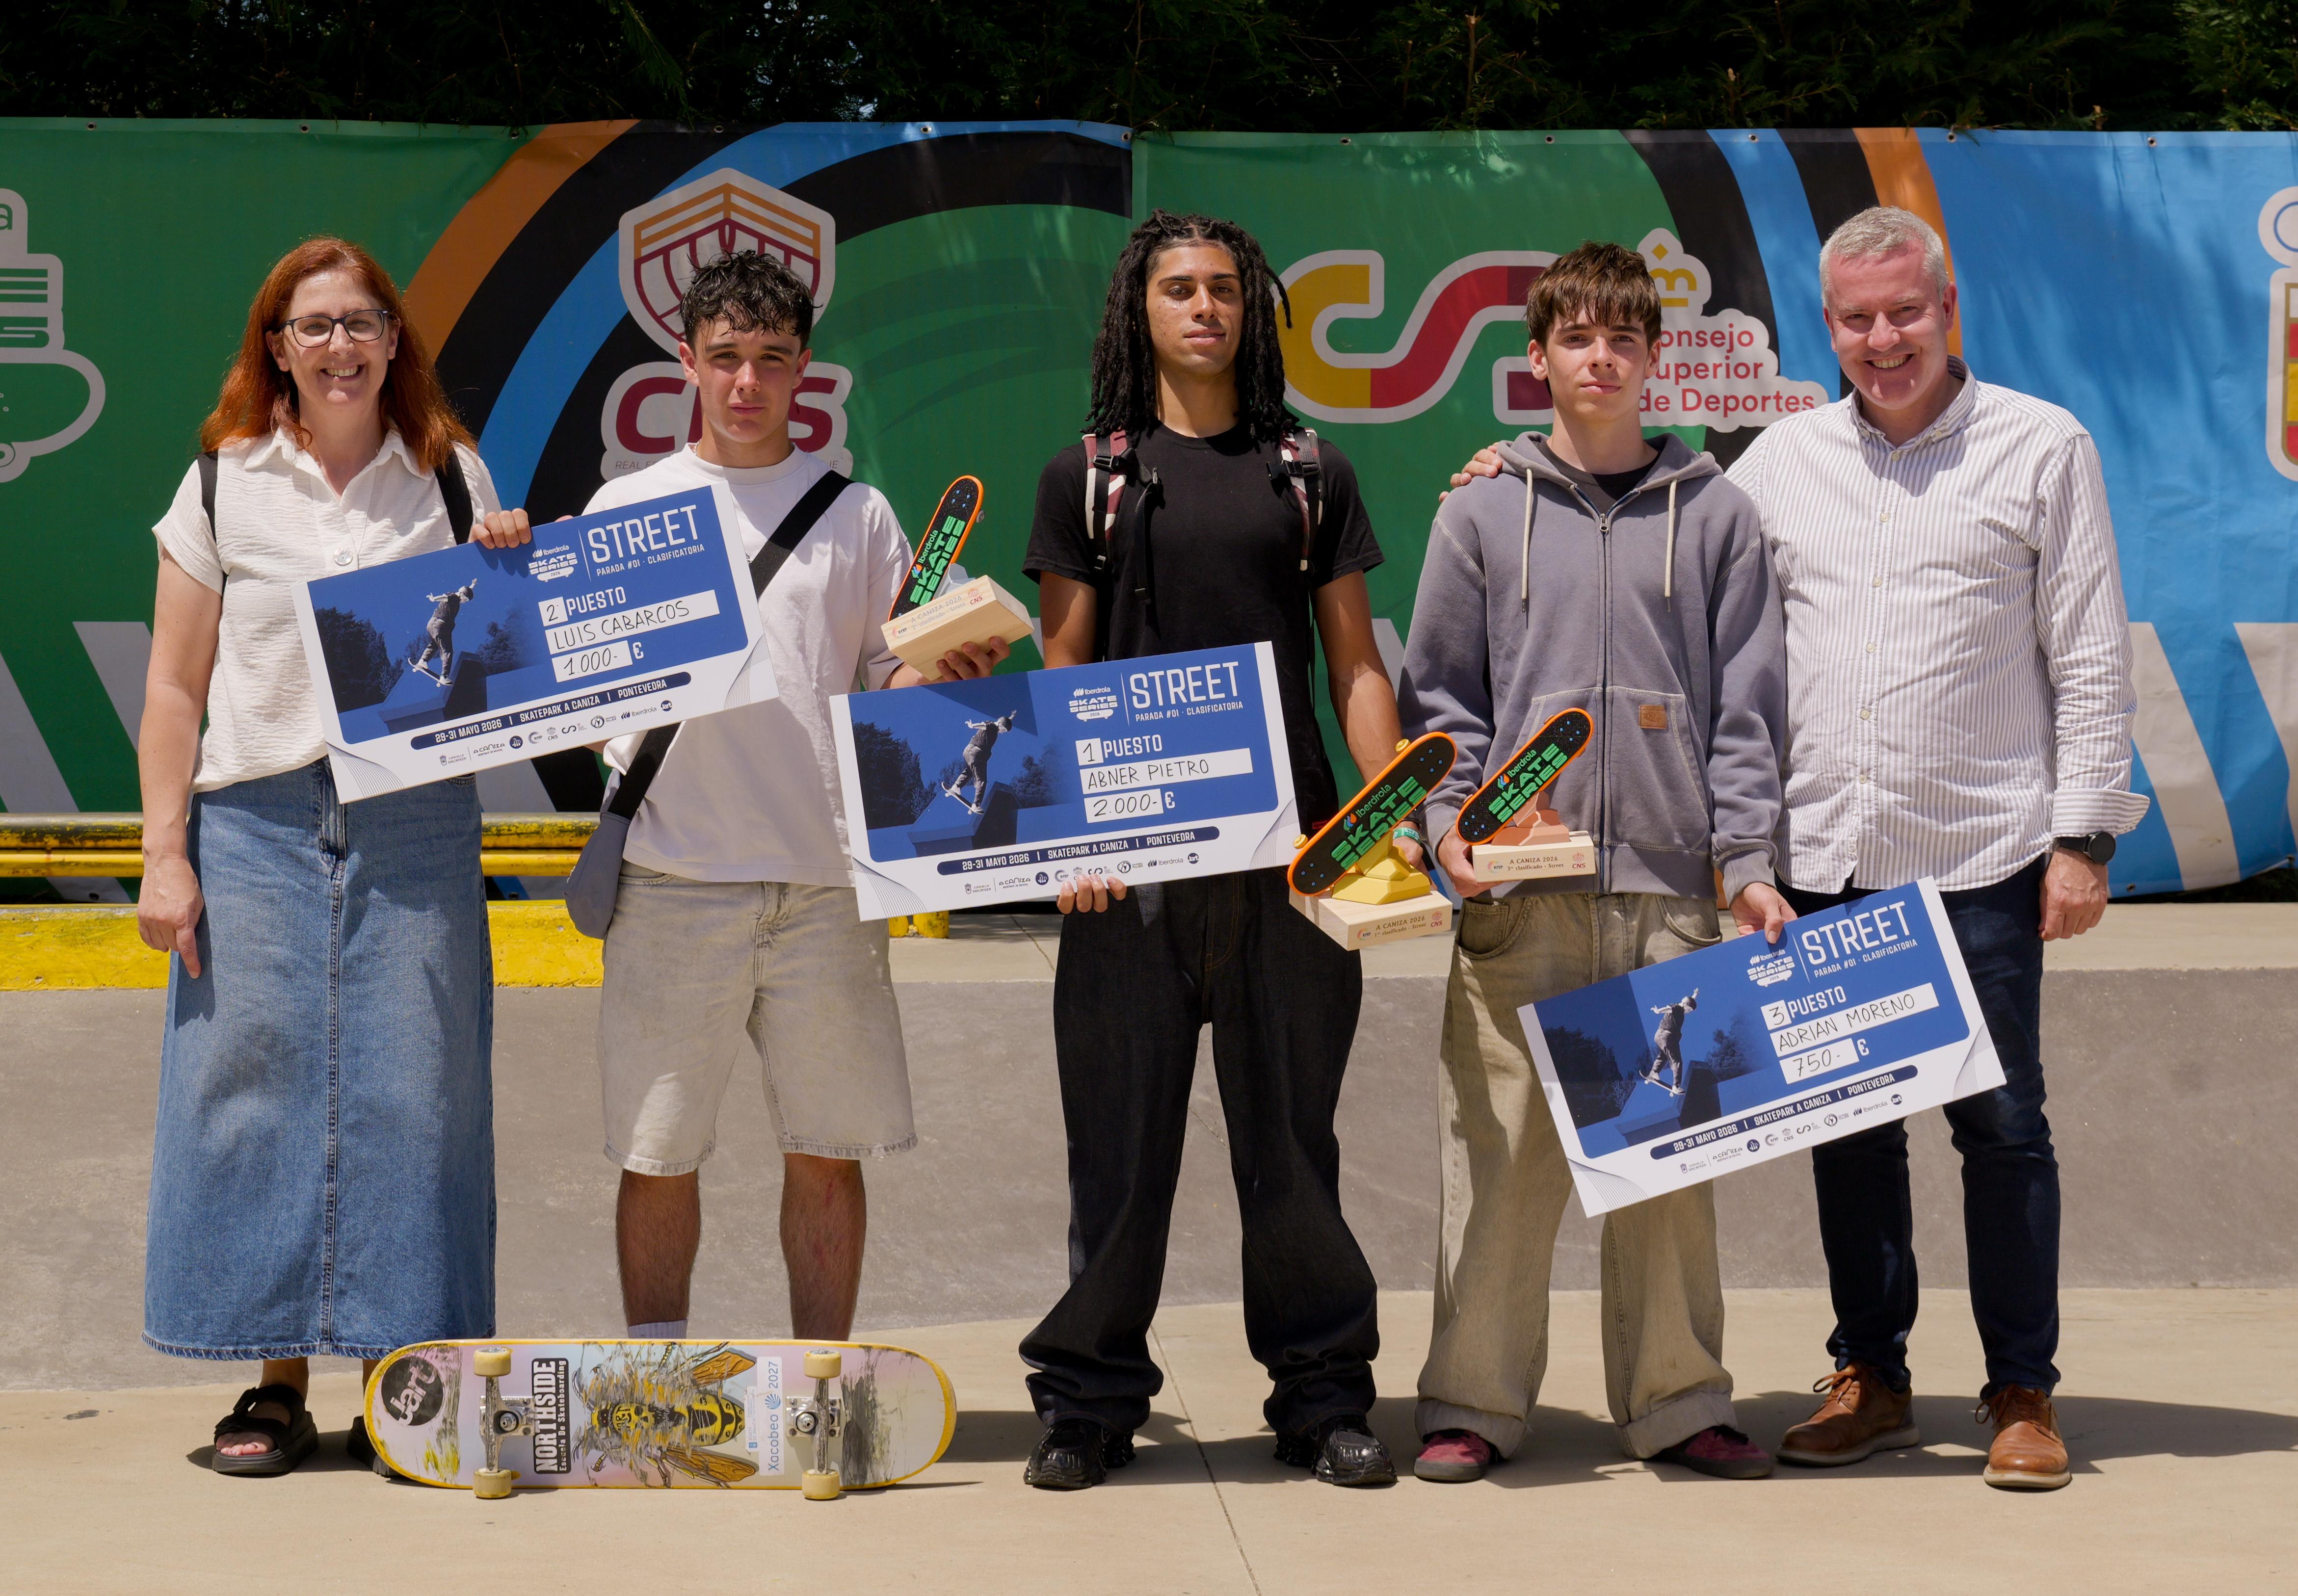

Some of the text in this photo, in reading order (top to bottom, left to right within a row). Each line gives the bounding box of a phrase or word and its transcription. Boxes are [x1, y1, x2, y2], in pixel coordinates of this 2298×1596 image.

[1660, 323, 1754, 354] onsejo
[1655, 355, 1764, 385] uperior
[615, 376, 838, 454] CS
[1639, 388, 1815, 418] de Deportes
[615, 461, 641, 470] REAL
[587, 505, 698, 564] STREET
[918, 530, 938, 564] Iberdrola
[528, 552, 577, 569] SKATE
[543, 545, 570, 556] Iberdrola
[596, 563, 625, 576] PARADA
[648, 544, 705, 565] CLASIFICATORIA
[910, 515, 956, 603] SKATE
[919, 520, 966, 606] SERIES
[530, 558, 578, 575] SERIES
[566, 586, 627, 616] PUESTO
[918, 604, 944, 620] CANIZA
[945, 595, 962, 607] 2026
[920, 612, 945, 627] clasificado
[950, 602, 966, 612] Street
[970, 595, 982, 605] CNS
[555, 601, 689, 650] LUIS CABARCOS
[633, 642, 644, 659] €
[1084, 686, 1110, 695] Iberdrola
[1130, 661, 1239, 709] STREET
[458, 724, 480, 737] MAYO
[482, 719, 502, 732] 2026
[520, 704, 562, 723] SKATEPARK
[564, 703, 570, 711] A
[571, 695, 601, 710] CANIZA
[618, 679, 667, 699] PONTEVEDRA
[632, 706, 657, 717] Iberdrola
[1069, 695, 1117, 707] SKATE
[1070, 702, 1118, 712] SERIES
[1135, 711, 1163, 722] PARADA
[1187, 701, 1243, 716] CLASIFICATORIA
[1083, 734, 1163, 762] 1 PUESTO
[1088, 759, 1209, 789] ABNER PIETRO
[1488, 743, 1559, 814] SKATE
[1507, 750, 1537, 778] Iberdrola
[1164, 791, 1176, 809] €
[1355, 785, 1392, 817] Iberdrola
[1497, 752, 1568, 823] SERIES
[1331, 776, 1419, 862] SKATE
[1340, 786, 1427, 870] SERIES
[986, 856, 1007, 867] MAYO
[1009, 853, 1030, 864] 2026
[1048, 846, 1090, 859] SKATEPARK
[1093, 845, 1098, 853] A
[1100, 840, 1129, 853] CANIZA
[1146, 832, 1195, 846] PONTEVEDRA
[1159, 858, 1184, 866] Iberdrola
[1382, 926, 1406, 936] clasificado
[1383, 919, 1407, 929] CANIZA
[1801, 901, 1910, 965] STREET
[1747, 956, 1794, 975] SKATE
[1759, 948, 1785, 961] Iberdrola
[1814, 963, 1842, 978] PARADA
[1862, 939, 1918, 962] CLASIFICATORIA
[1749, 961, 1795, 981] SERIES
[1787, 986, 1847, 1018] PUESTO
[1779, 994, 1915, 1051] ADRIAN MORENO
[1857, 1039, 1870, 1056] €
[1695, 1130, 1717, 1145] MAYO
[1718, 1124, 1738, 1138] 2026
[1754, 1106, 1795, 1126] SKATEPARK
[1796, 1104, 1803, 1113] A
[1803, 1095, 1832, 1110] CANIZA
[1848, 1073, 1895, 1097] PONTEVEDRA
[1863, 1101, 1888, 1112] Iberdrola
[533, 1361, 558, 1472] NORTHSIDE
[557, 1360, 567, 1471] Escuela De Skateboarding
[768, 1361, 779, 1470] Xacobeo 2027
